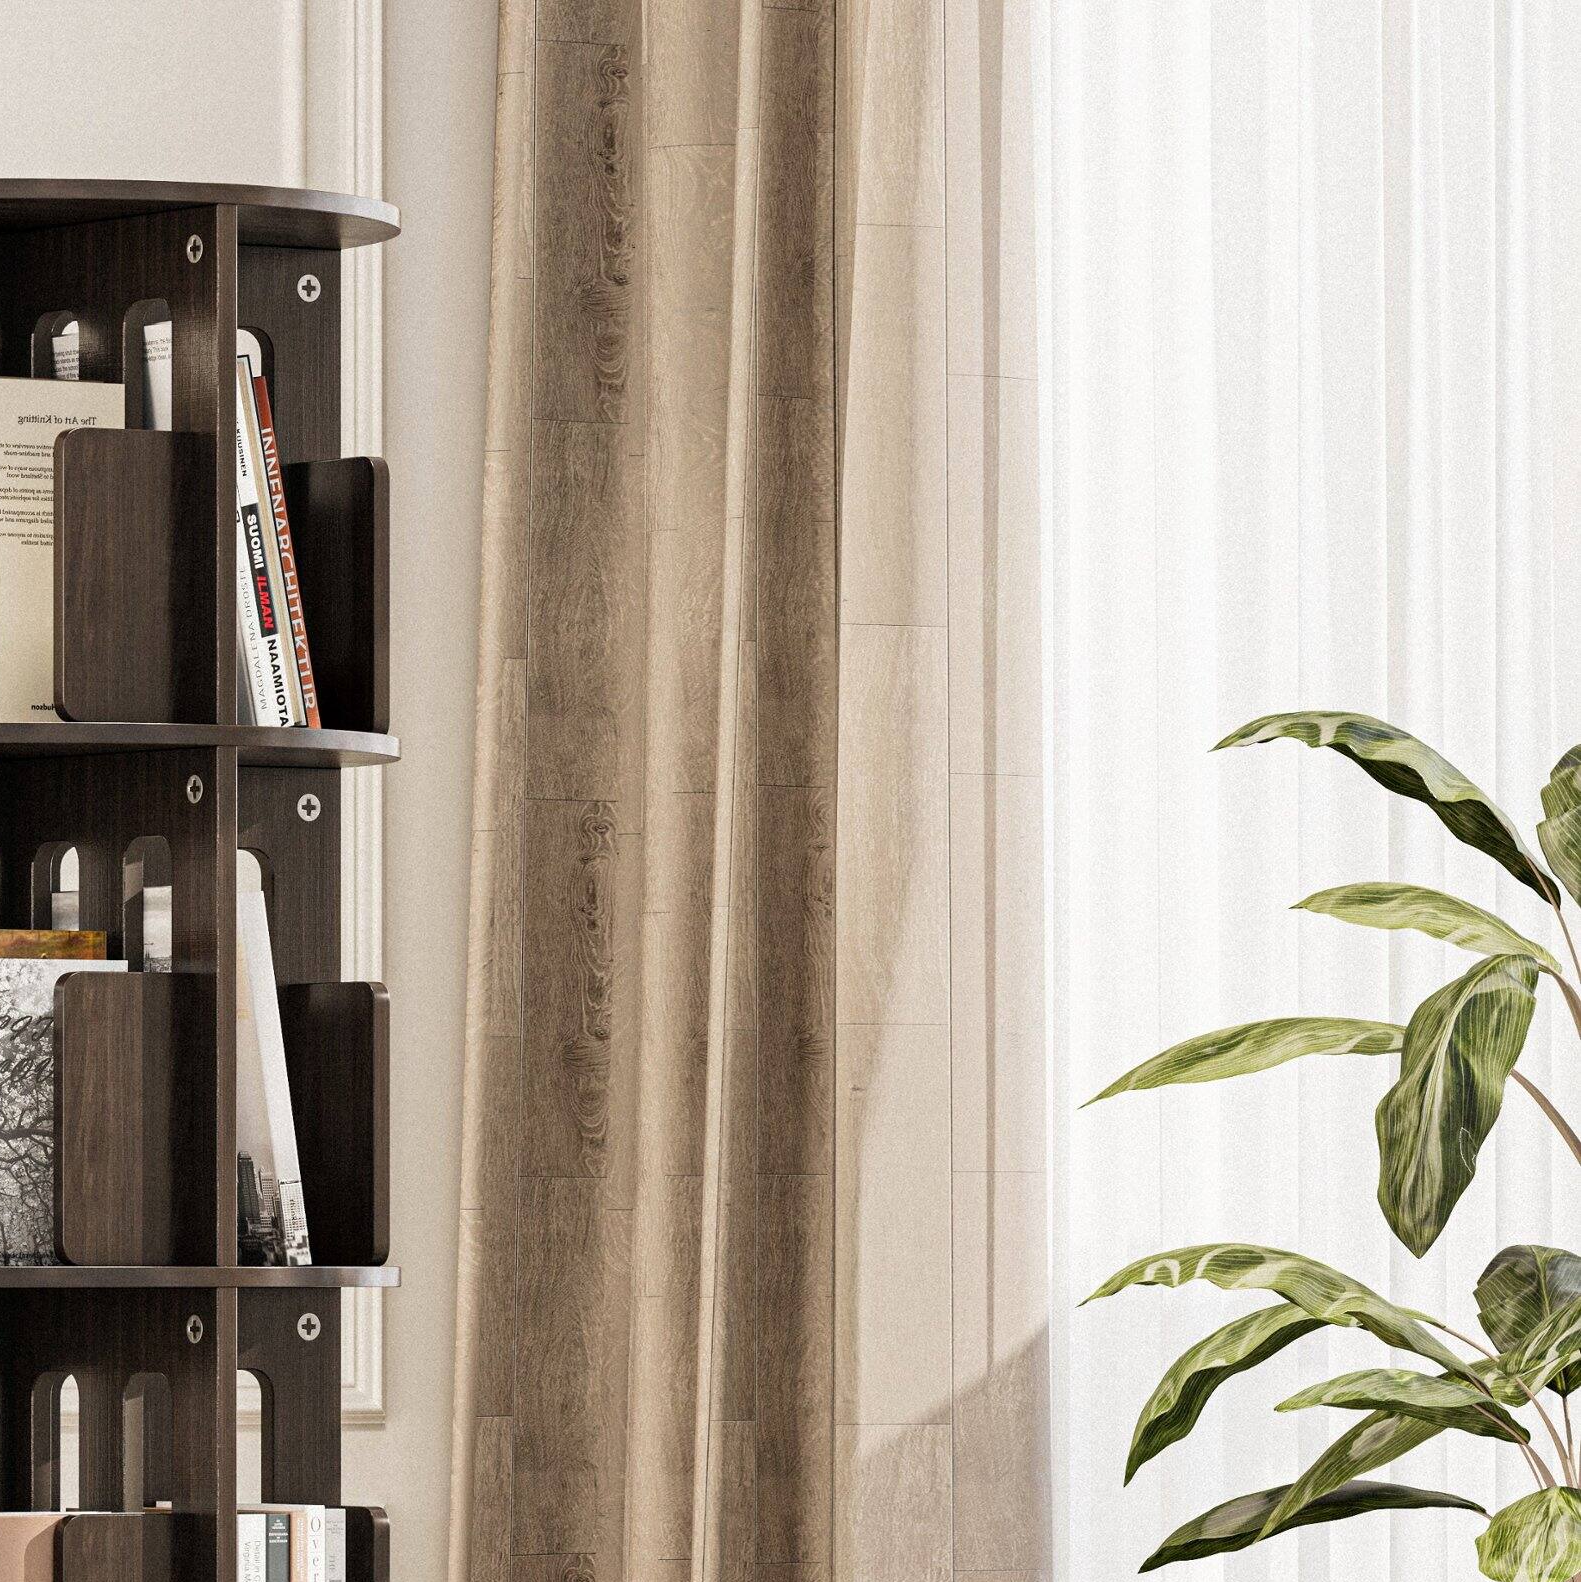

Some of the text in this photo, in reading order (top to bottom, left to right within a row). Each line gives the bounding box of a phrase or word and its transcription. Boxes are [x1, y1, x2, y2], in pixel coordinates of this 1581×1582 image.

[246, 513, 290, 727] SUOMI ILMAN NAAMIOTA
